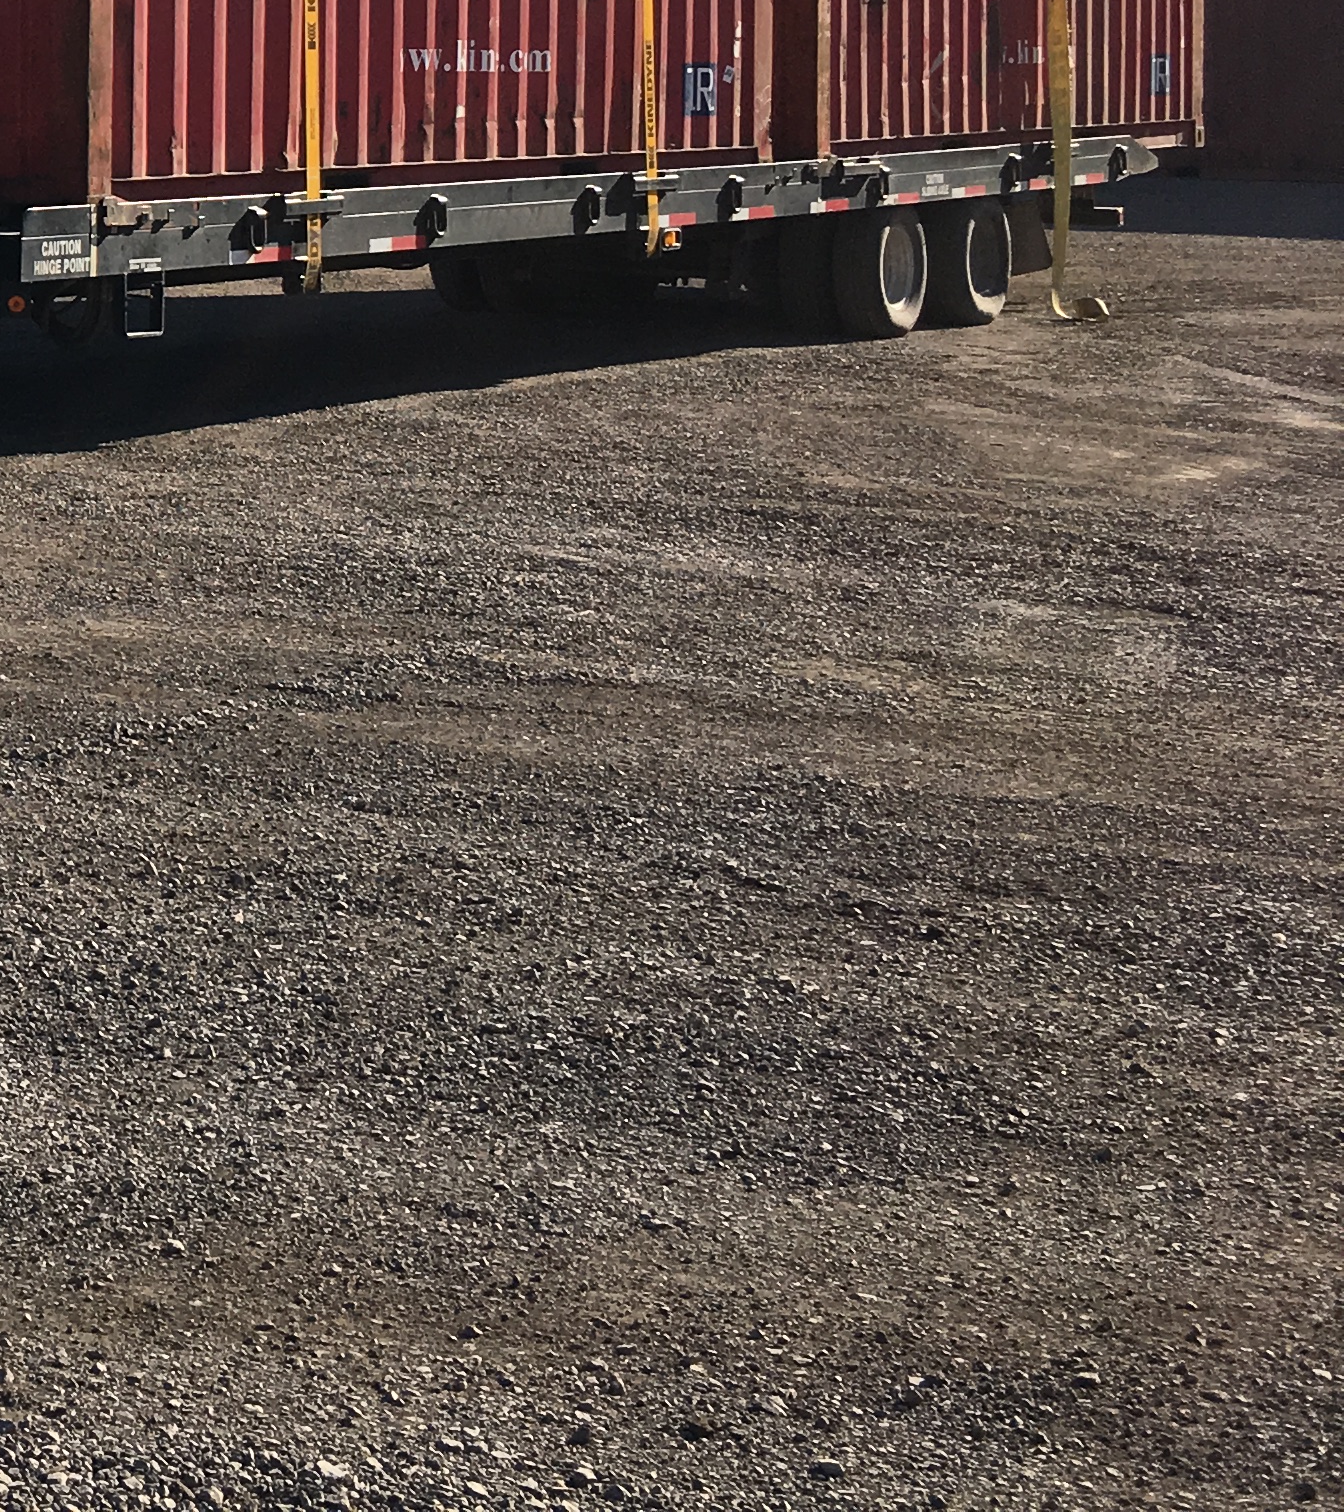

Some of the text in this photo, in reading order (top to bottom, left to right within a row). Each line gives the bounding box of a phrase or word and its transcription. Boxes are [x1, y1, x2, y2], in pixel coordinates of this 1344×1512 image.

[41, 239, 81, 256] CAUTION
[33, 256, 90, 275] HINGE POINT
